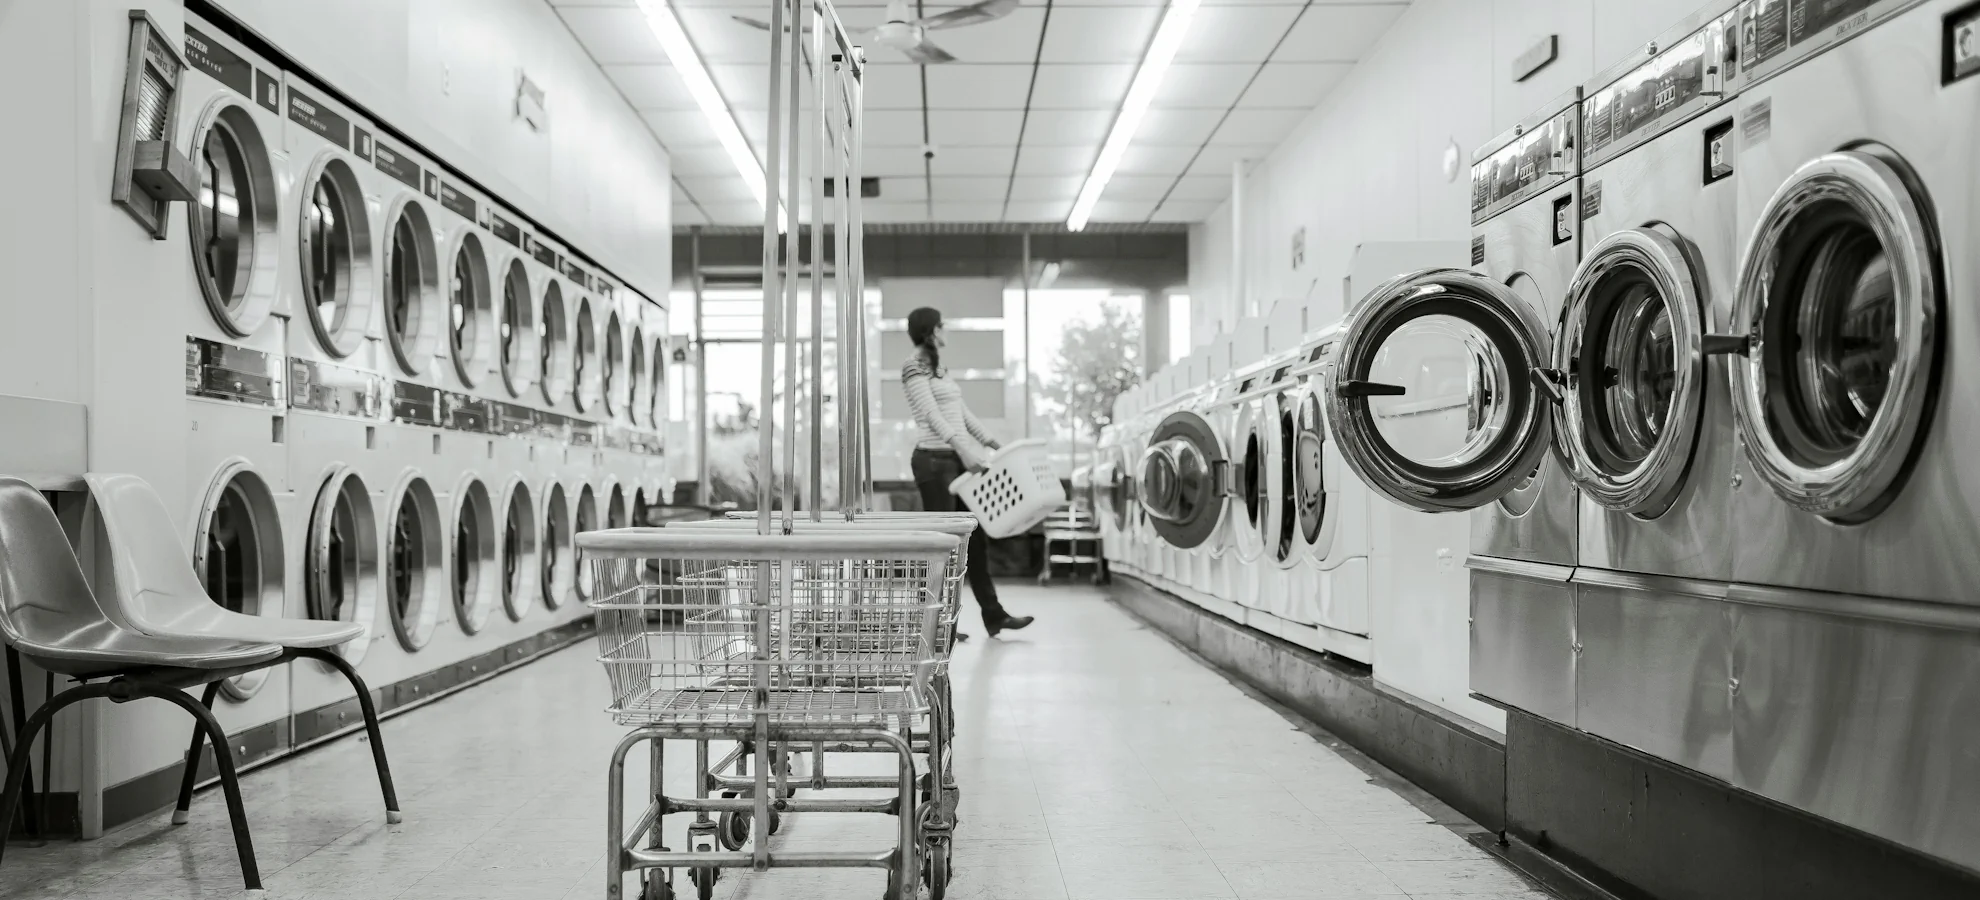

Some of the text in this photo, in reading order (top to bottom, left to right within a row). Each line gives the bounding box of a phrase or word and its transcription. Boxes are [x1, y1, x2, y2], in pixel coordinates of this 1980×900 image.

[1836, 11, 1869, 36] DEXTER
[184, 34, 209, 54] EXTER
[191, 420, 199, 432] 20
